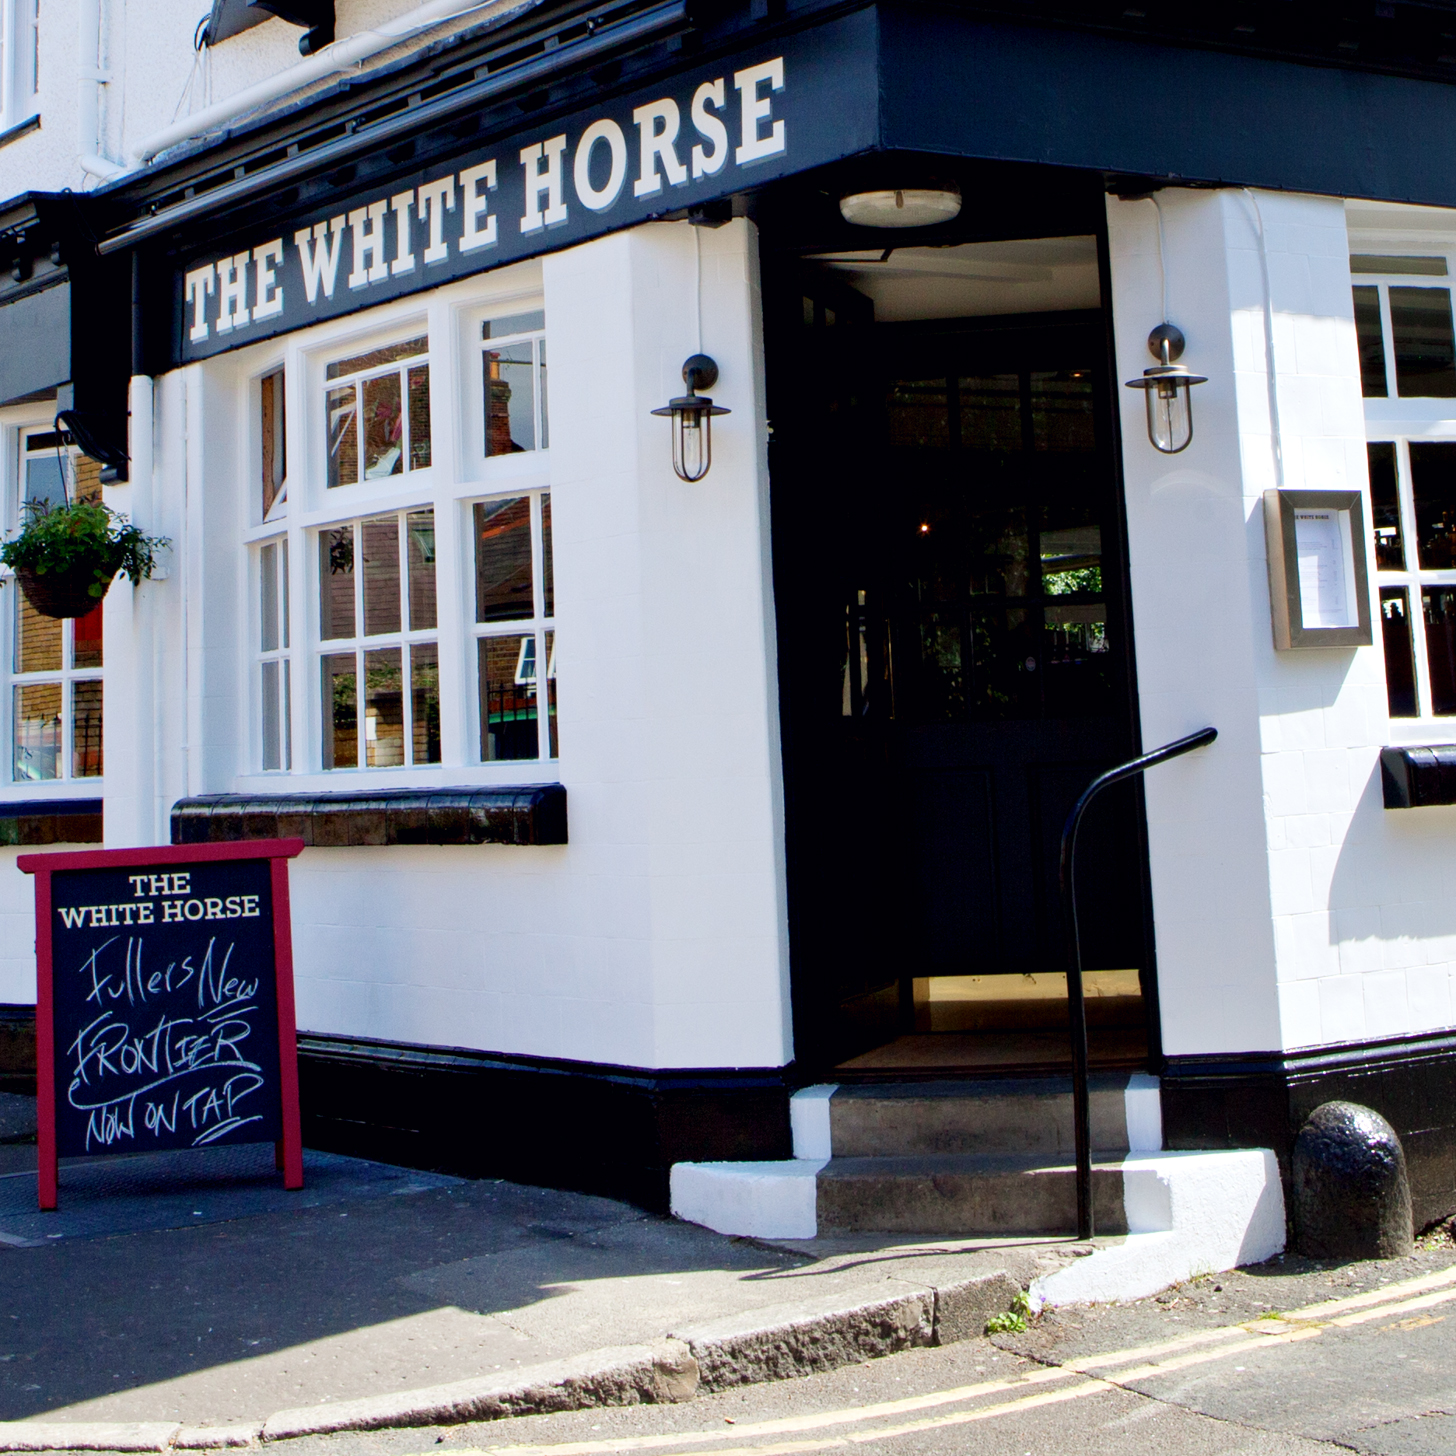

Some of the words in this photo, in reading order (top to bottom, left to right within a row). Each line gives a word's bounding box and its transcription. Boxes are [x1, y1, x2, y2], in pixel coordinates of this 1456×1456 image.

[185, 238, 285, 343] THE
[294, 159, 498, 304] WHITE
[519, 56, 786, 235] HORSE
[57, 902, 155, 929] WHITE
[161, 895, 260, 923] HORSE
[129, 872, 191, 897] THE
[79, 935, 194, 1006] Fullers
[197, 936, 260, 1009] New
[66, 1011, 252, 1085] FRONTIER
[144, 1090, 180, 1137] ON
[182, 1073, 265, 1129] TAP
